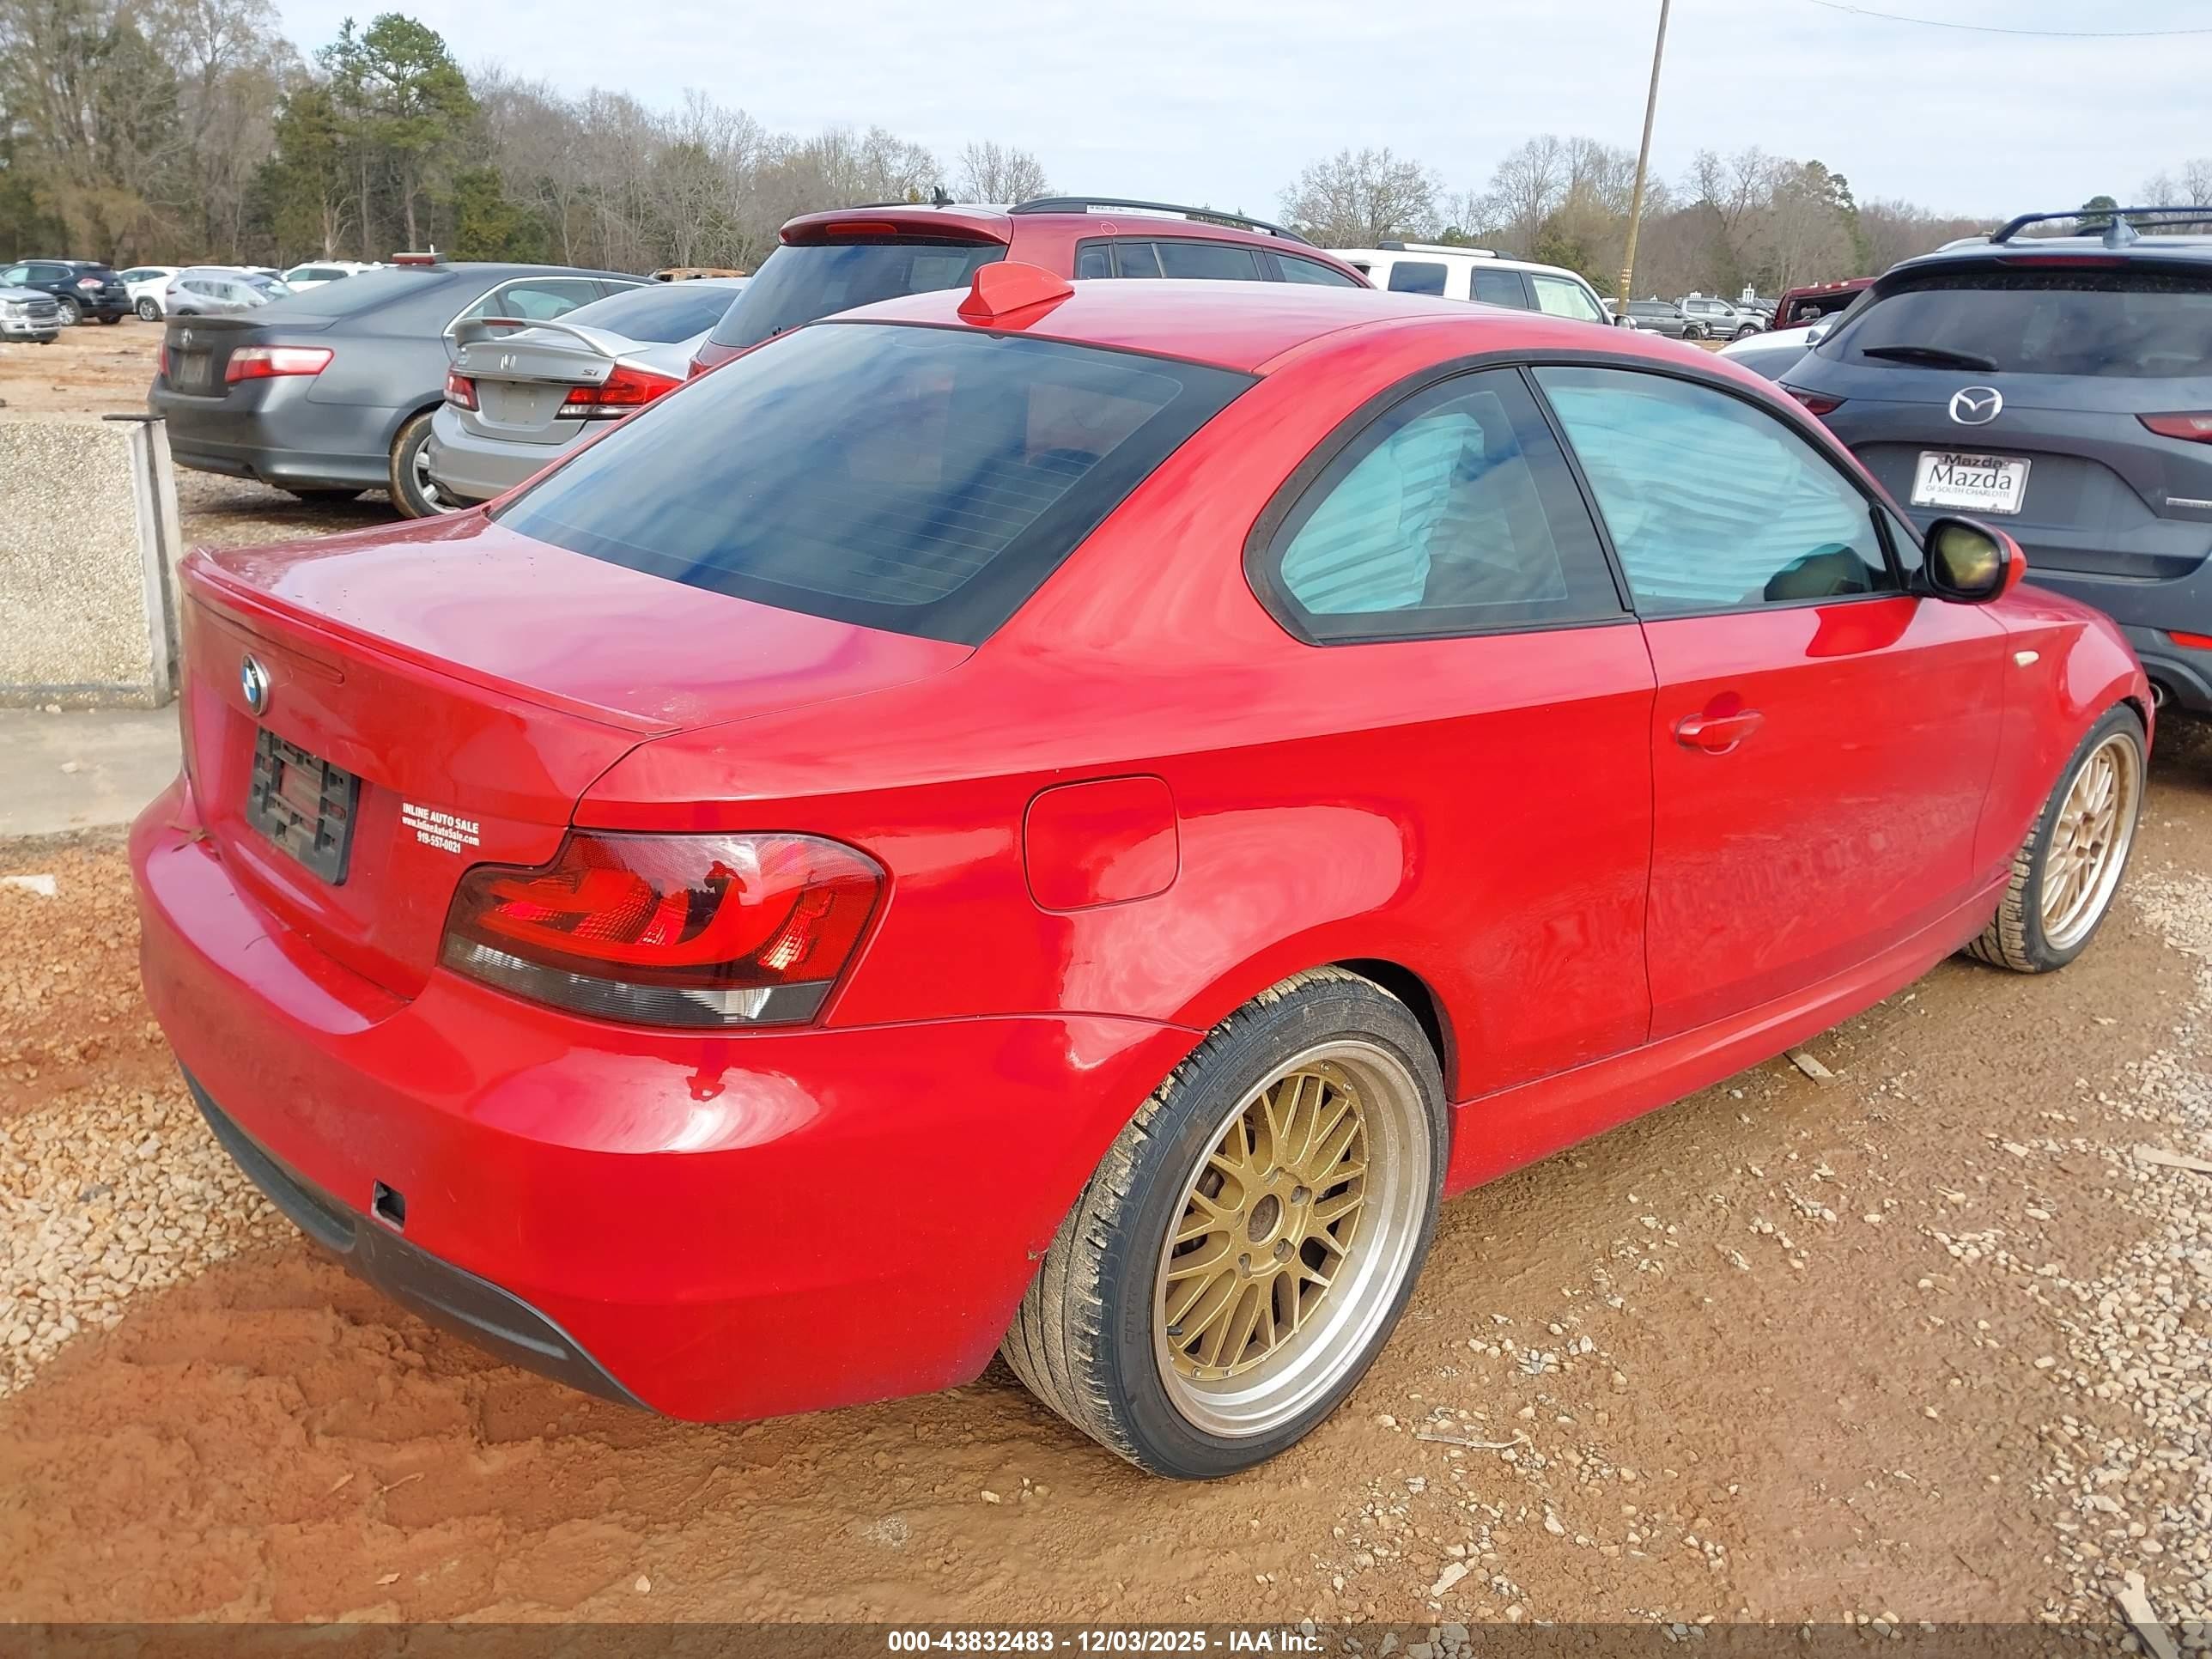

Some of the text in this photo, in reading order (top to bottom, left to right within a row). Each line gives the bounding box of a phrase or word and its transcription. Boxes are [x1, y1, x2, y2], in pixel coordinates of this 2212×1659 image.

[1944, 454, 2003, 469] Mazda
[1929, 465, 2012, 490] Mazda
[1937, 486, 1964, 495] SOUTH
[1966, 489, 2010, 498] CHARLOTTE
[402, 802, 479, 835] INLINE AUTO SALE
[416, 830, 461, 854] 919-557-0021
